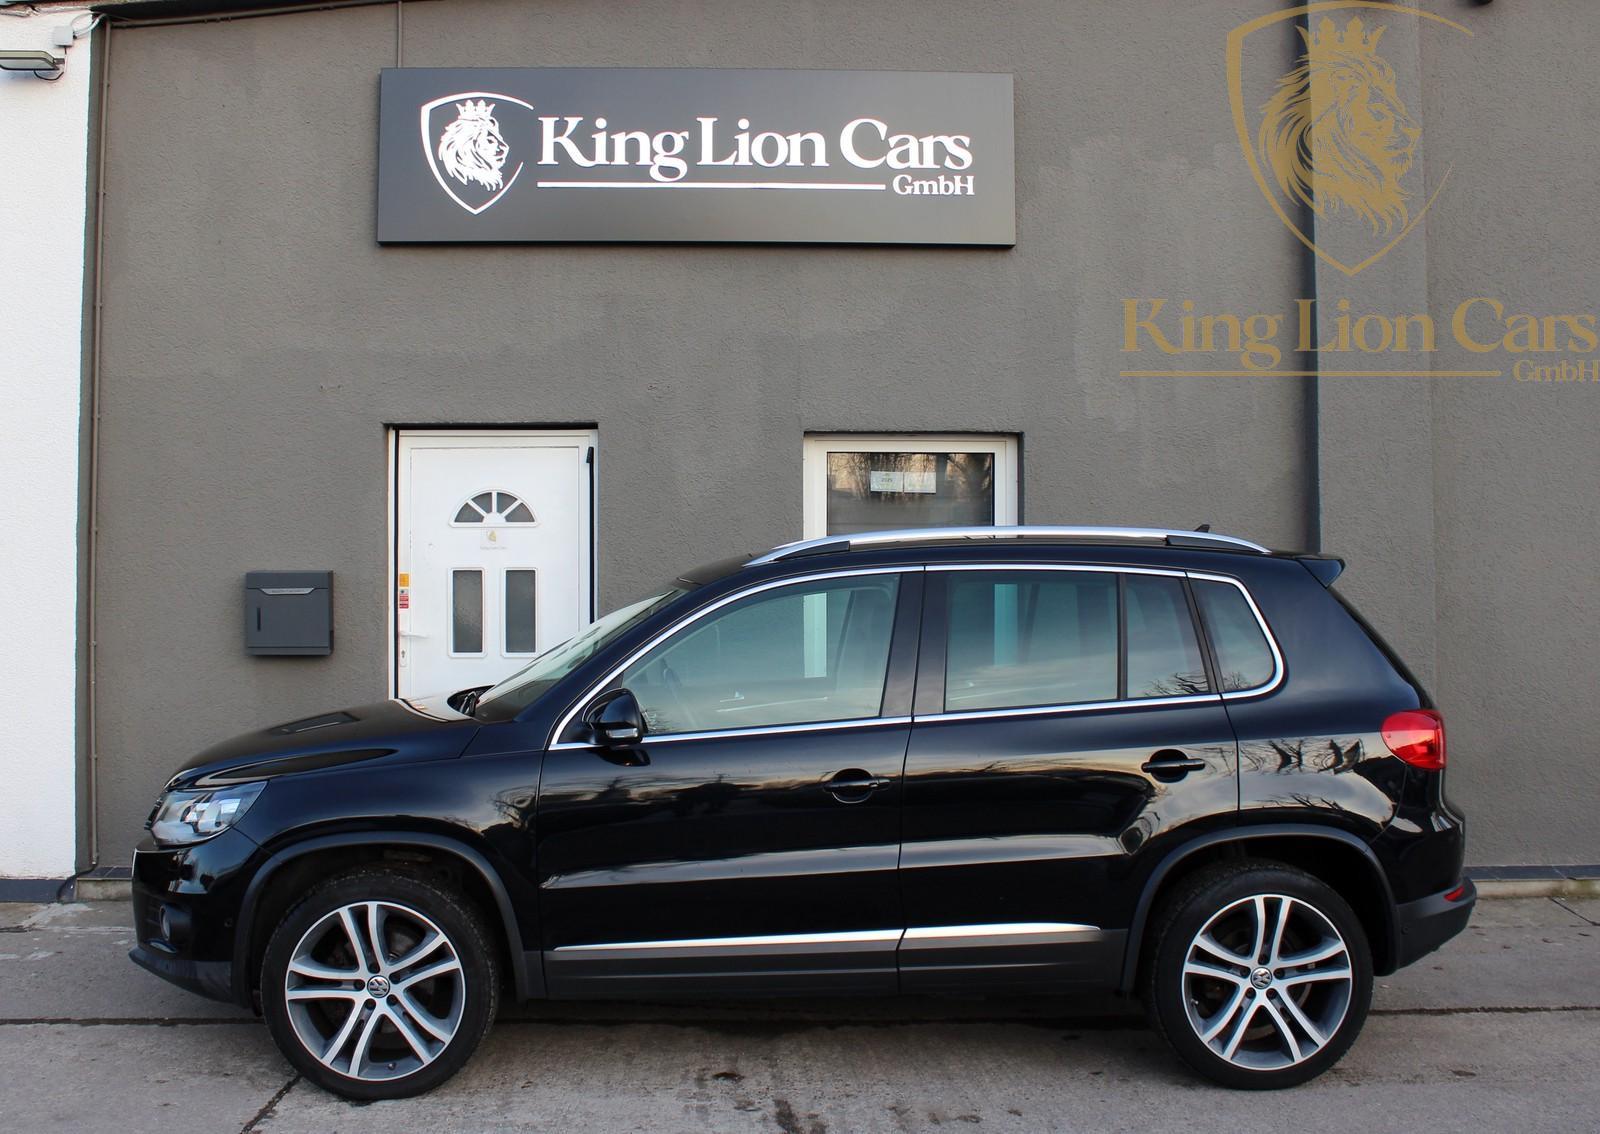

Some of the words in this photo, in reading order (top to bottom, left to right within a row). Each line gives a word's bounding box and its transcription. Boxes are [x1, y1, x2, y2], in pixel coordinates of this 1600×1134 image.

[537, 116, 689, 182] King
[696, 116, 829, 167] Lion
[839, 117, 973, 170] Cars
[892, 174, 975, 196] GmbH
